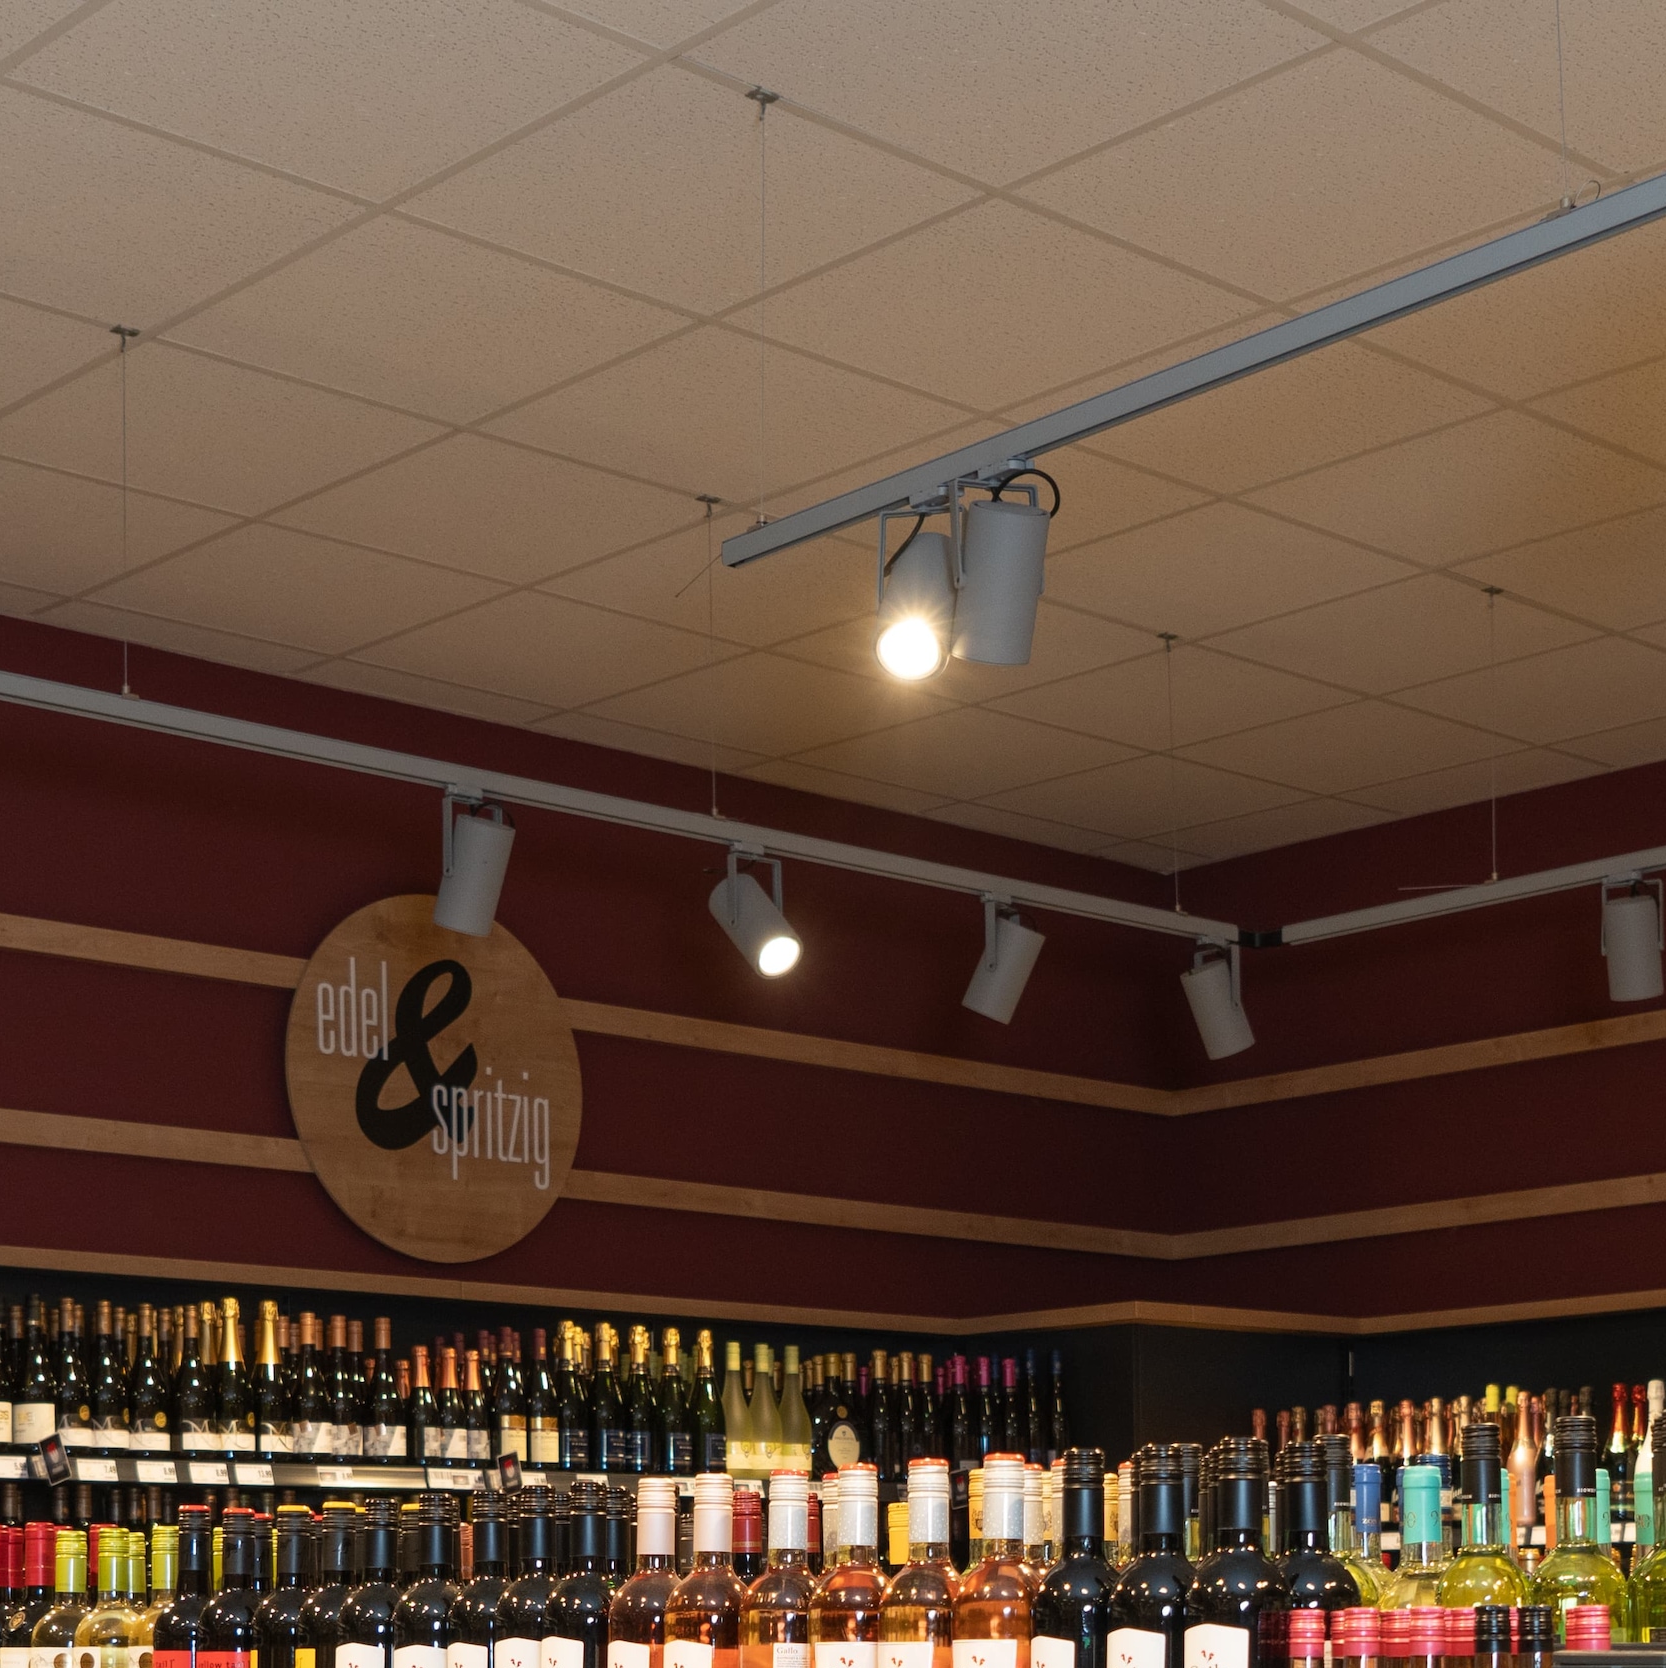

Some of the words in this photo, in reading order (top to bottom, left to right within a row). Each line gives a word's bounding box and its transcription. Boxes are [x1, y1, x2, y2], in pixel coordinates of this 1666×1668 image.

[316, 956, 390, 1061] edel
[355, 959, 479, 1150] &
[432, 1067, 551, 1190] spritzig
